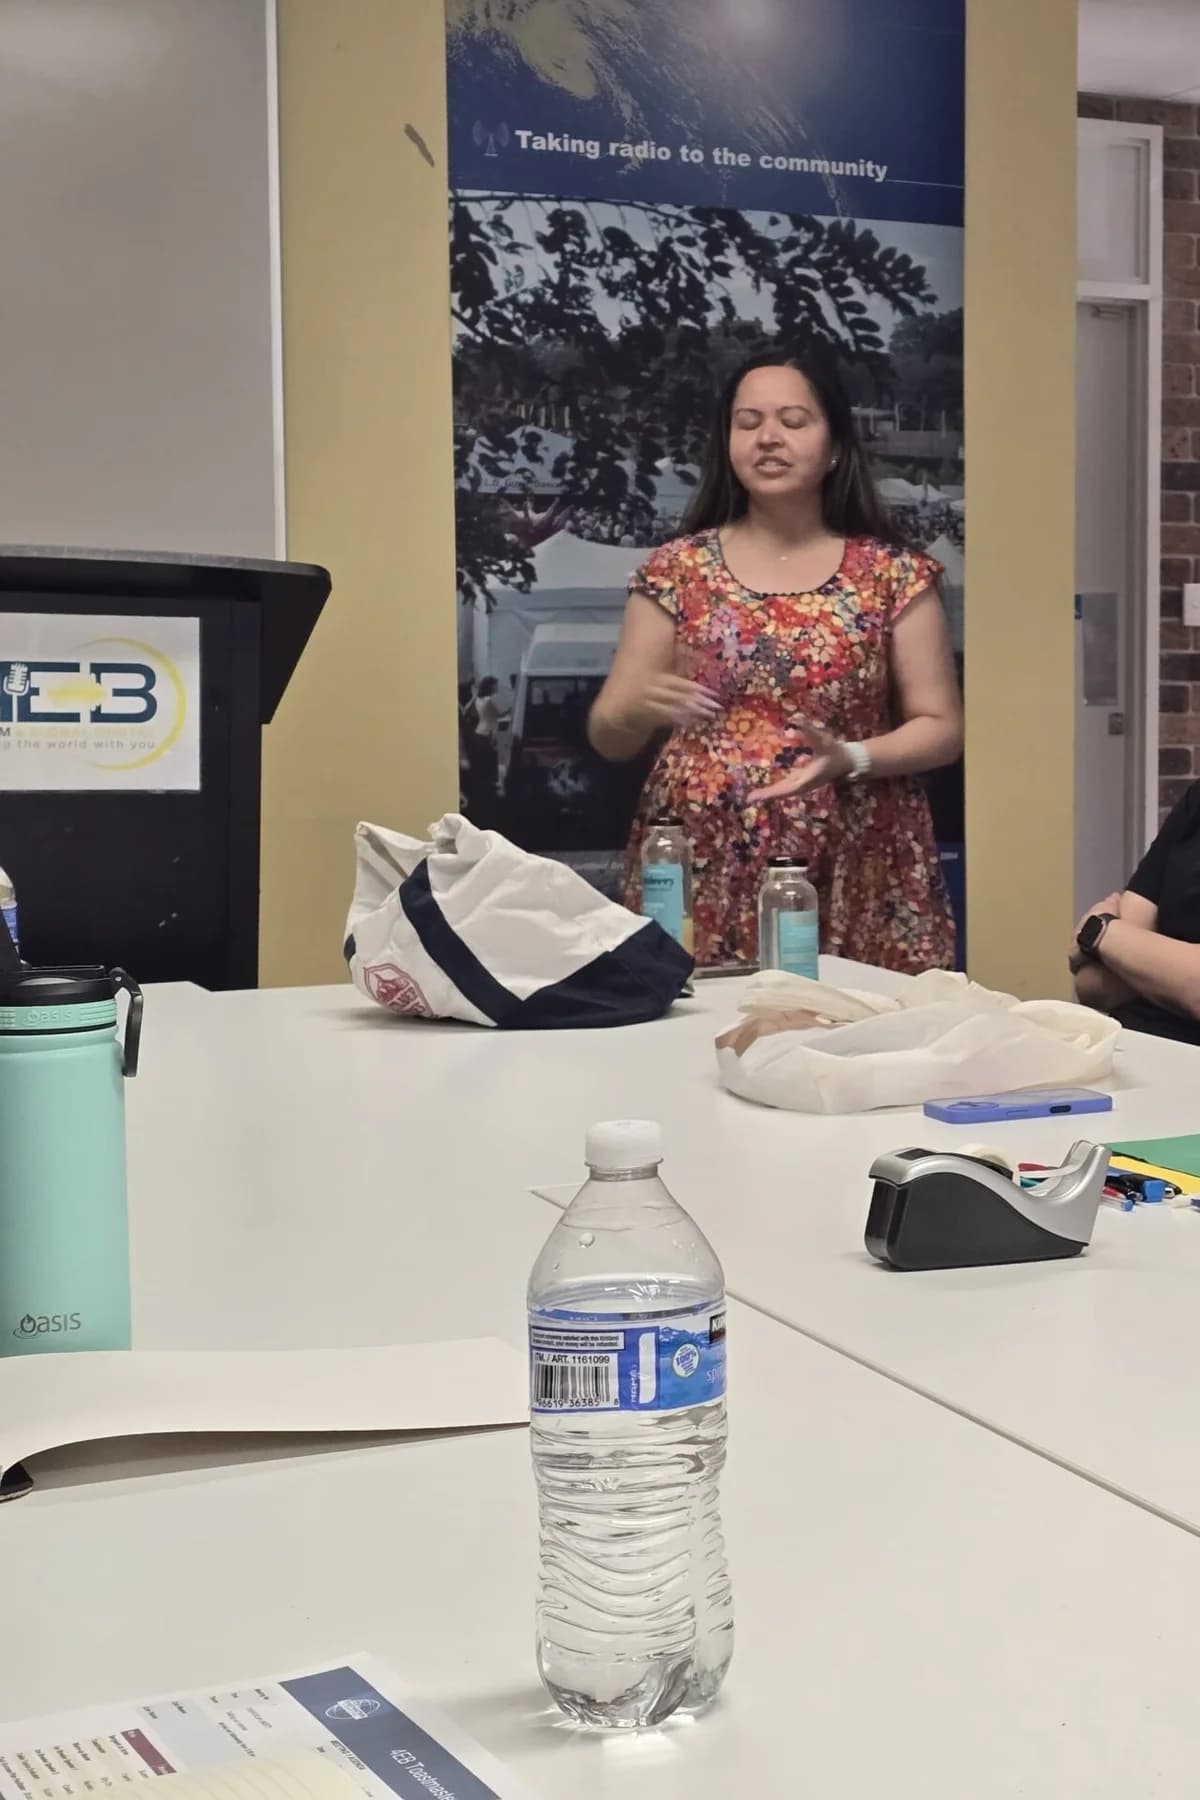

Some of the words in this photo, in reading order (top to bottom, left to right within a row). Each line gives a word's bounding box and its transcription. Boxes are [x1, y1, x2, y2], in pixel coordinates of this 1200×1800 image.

[515, 130, 600, 159] Taking
[609, 135, 671, 161] radio
[680, 144, 704, 164] to
[713, 147, 751, 168] the
[759, 153, 888, 182] community
[17, 739, 40, 749] the
[47, 739, 88, 750] world
[93, 740, 125, 750] with
[130, 741, 156, 752] you
[552, 1354, 570, 1363] ART.
[572, 1355, 610, 1364] 1161099
[569, 1399, 601, 1408] 36385
[389, 1748, 417, 1765] 4EB
